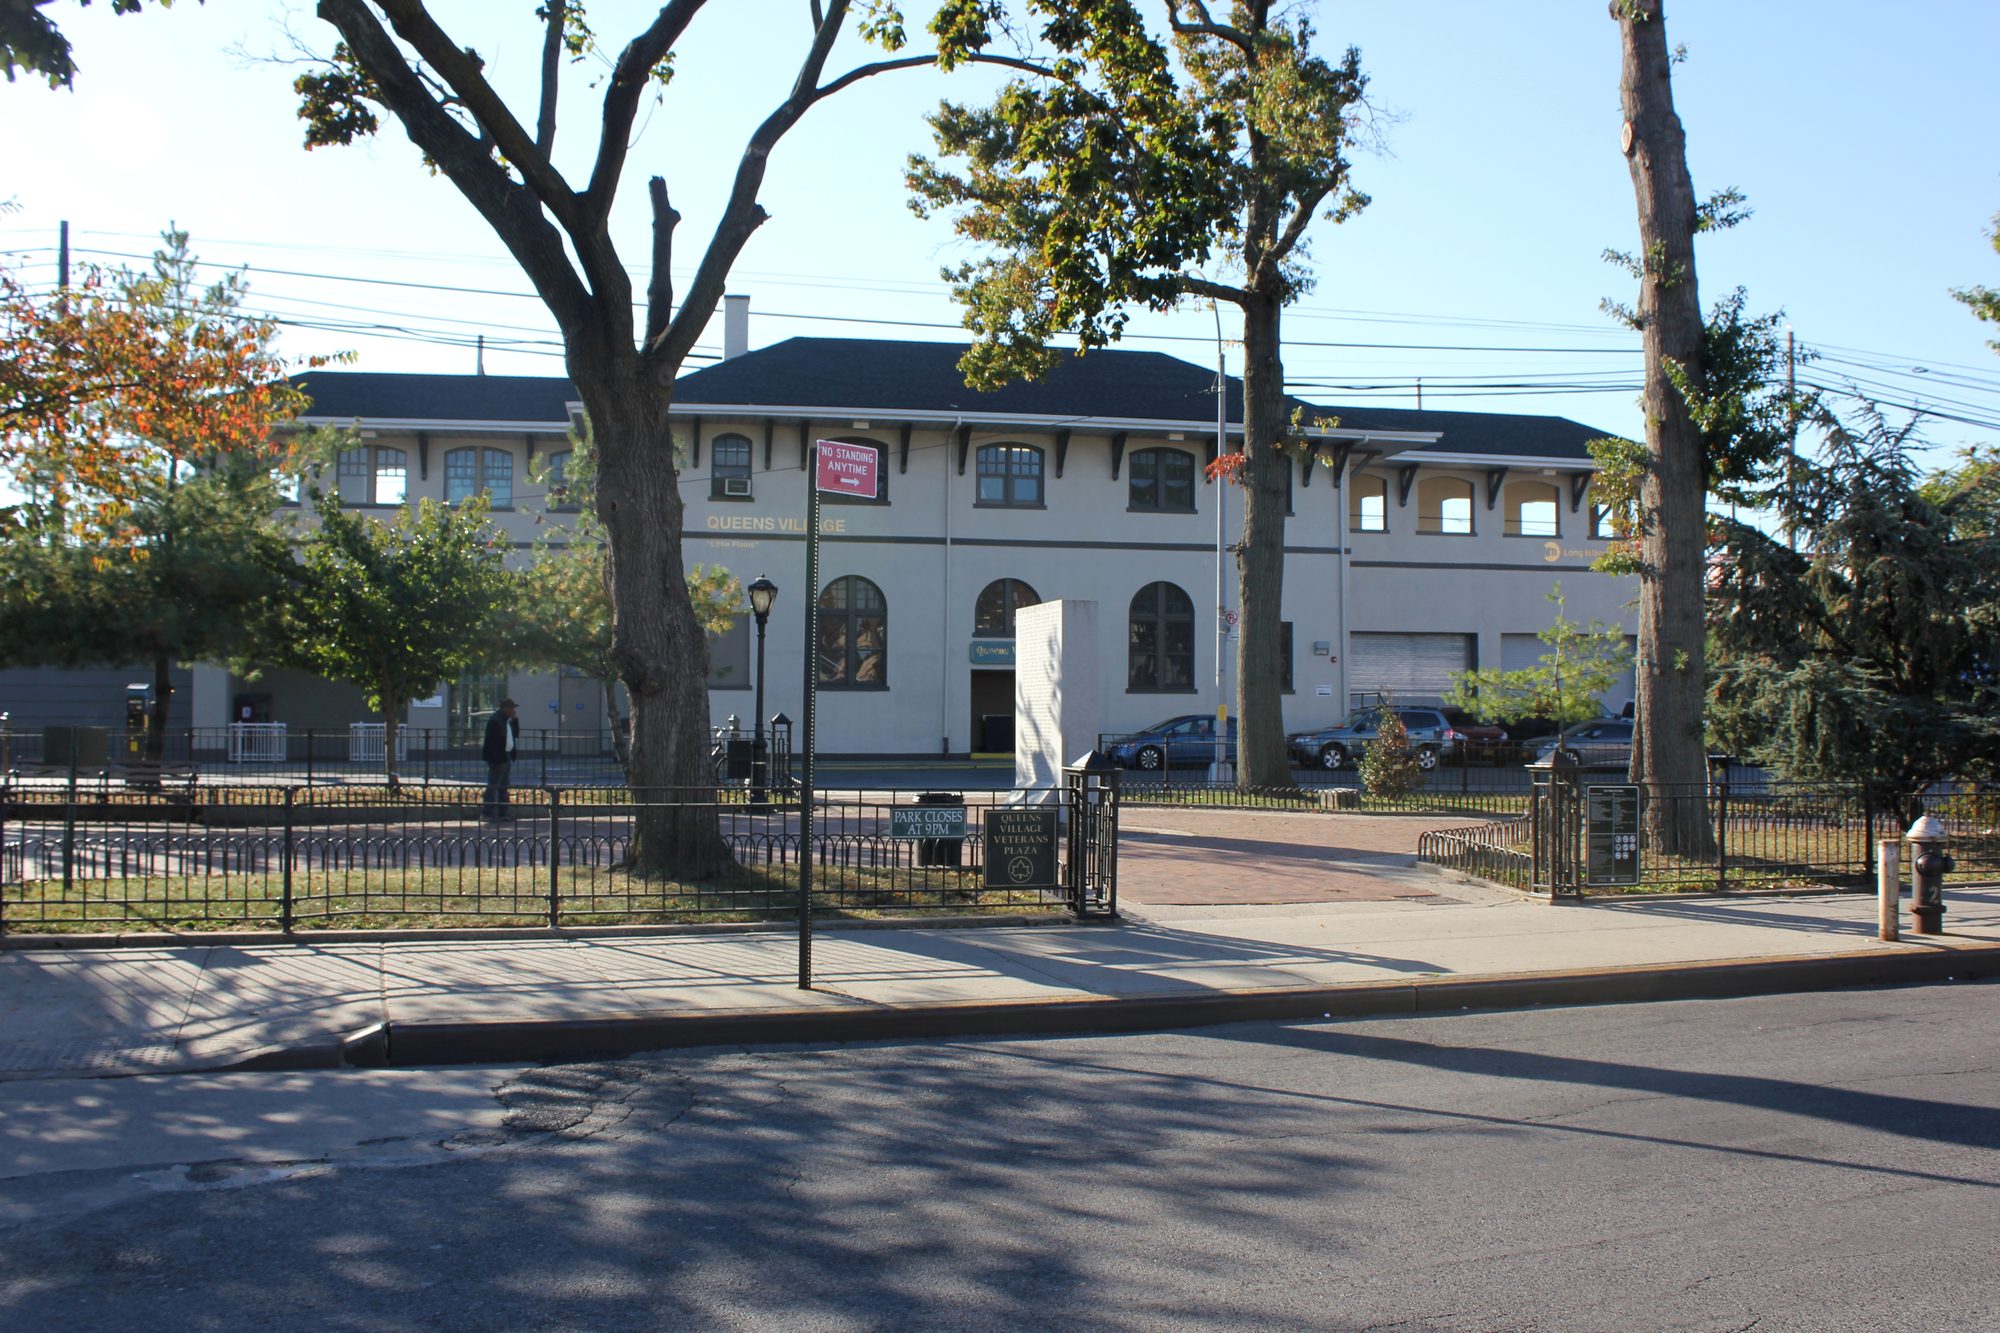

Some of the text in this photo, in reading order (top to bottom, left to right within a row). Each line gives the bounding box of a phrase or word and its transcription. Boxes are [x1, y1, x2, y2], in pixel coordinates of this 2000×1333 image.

[821, 446, 874, 464] NO STANDING
[827, 460, 868, 476] ANYTIME
[706, 515, 775, 530] QUEENS
[894, 811, 963, 823] PARK CLOSES
[1001, 814, 1042, 823] QUEENS
[907, 823, 949, 835] AT 9PM
[1000, 824, 1043, 833] VILLAGE
[993, 835, 1049, 844] VETERANS
[1004, 846, 1038, 855] PLAZA
